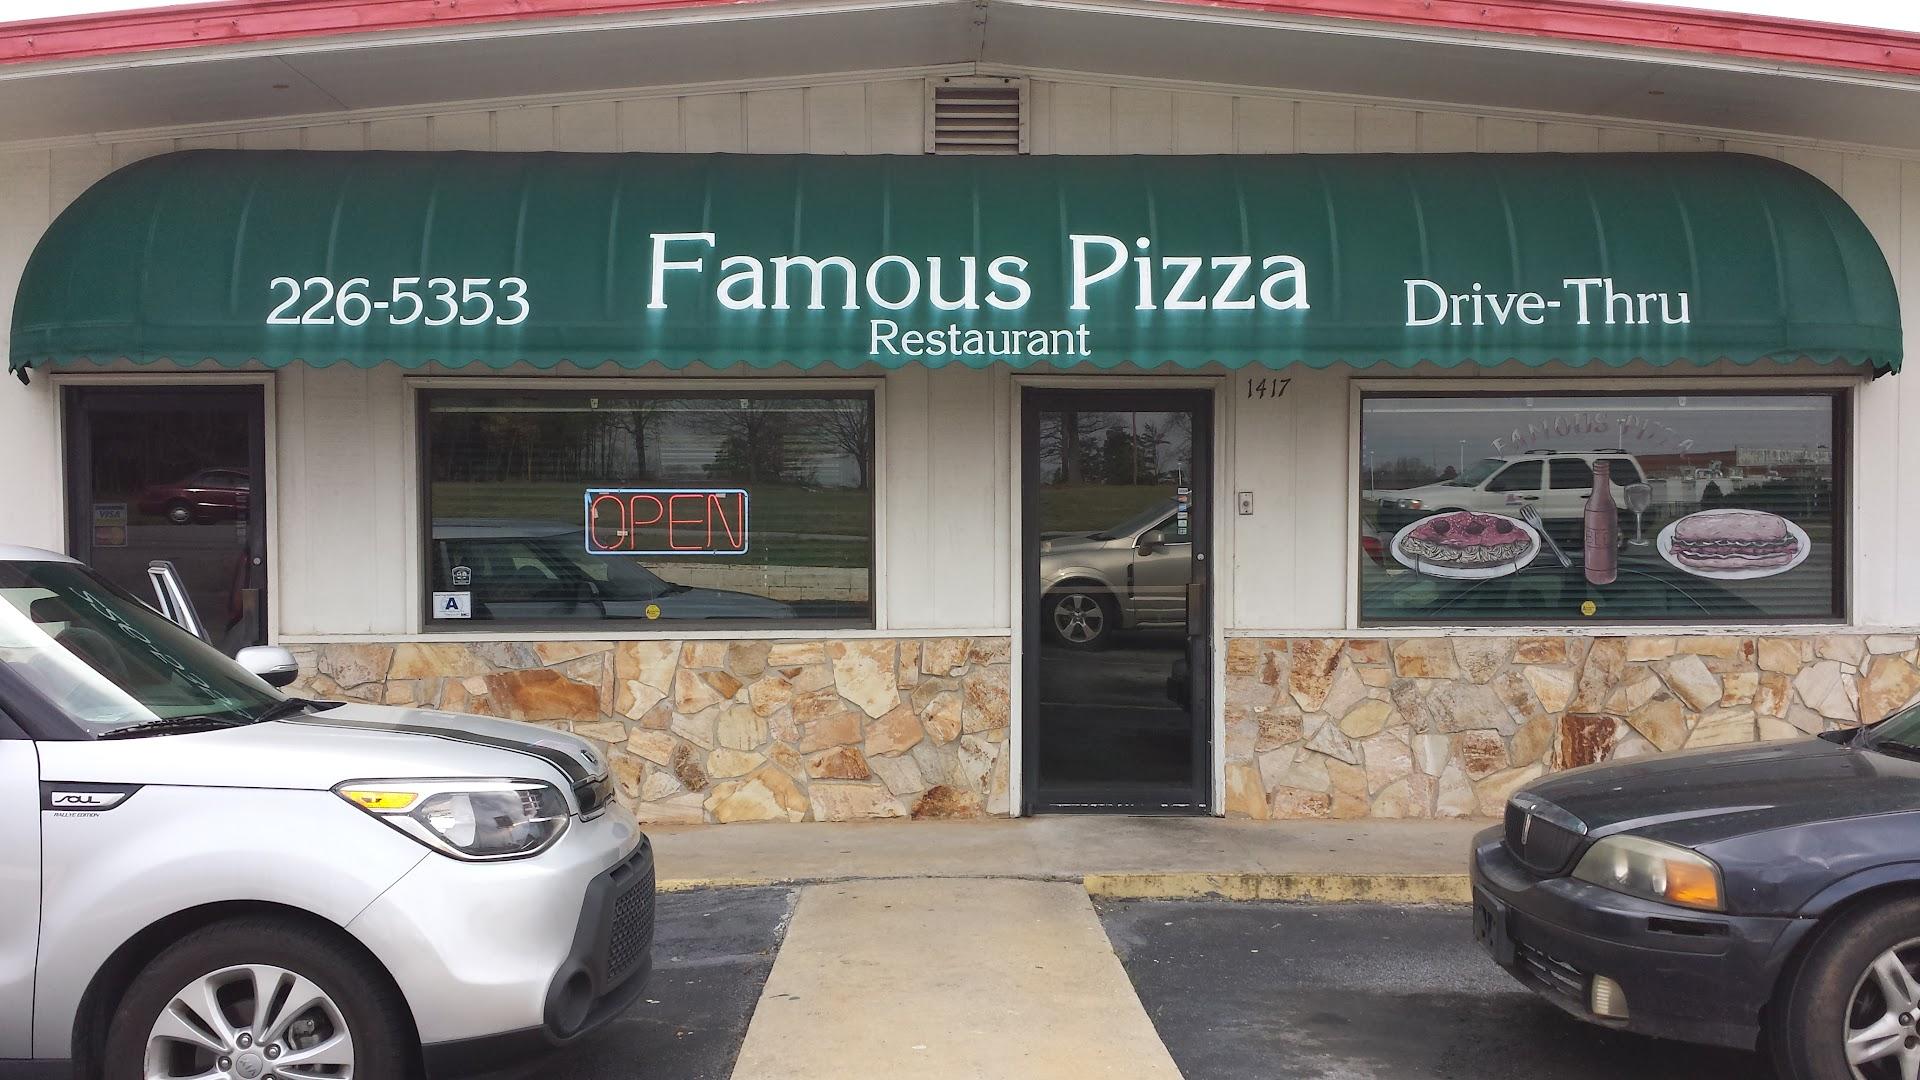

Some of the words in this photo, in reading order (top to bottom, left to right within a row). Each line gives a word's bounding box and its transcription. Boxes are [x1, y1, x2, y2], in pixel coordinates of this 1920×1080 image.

[647, 233, 1030, 310] Famous
[1069, 234, 1310, 310] Pizza
[266, 277, 529, 326] 226-5353
[1404, 278, 1689, 326] Drive-Thru
[869, 319, 1090, 356] Restaurant
[1247, 378, 1291, 399] 1417
[1490, 413, 1609, 454] FAMOUS
[591, 493, 742, 549] OPEN
[445, 597, 459, 610] A
[54, 795, 101, 804] SOUL
